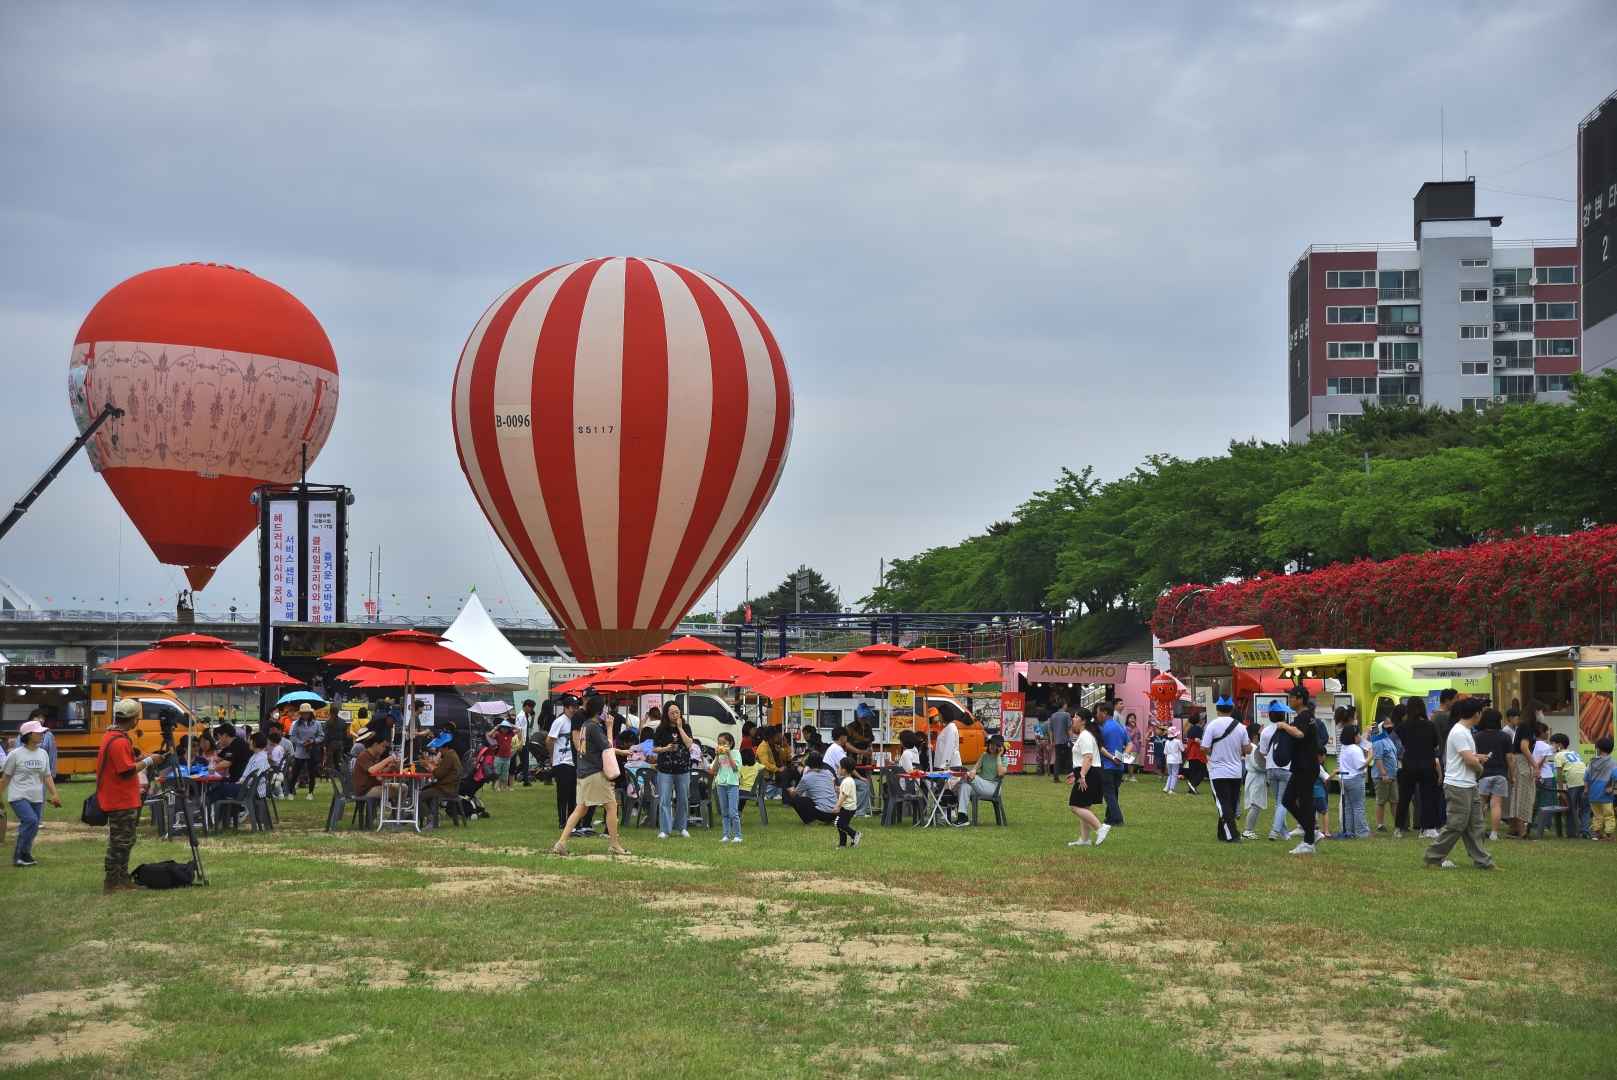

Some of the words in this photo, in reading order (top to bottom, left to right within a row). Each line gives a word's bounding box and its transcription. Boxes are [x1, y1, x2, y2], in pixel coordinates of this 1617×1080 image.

[1602, 234, 1609, 262] 2
[495, 414, 530, 428] B-0096
[285, 535, 297, 563] 서비스
[273, 554, 284, 583] 아시아
[286, 566, 296, 586] 센터
[286, 589, 294, 598] &
[286, 601, 295, 621] 판매
[1040, 665, 1116, 678] ANDAMIRO
